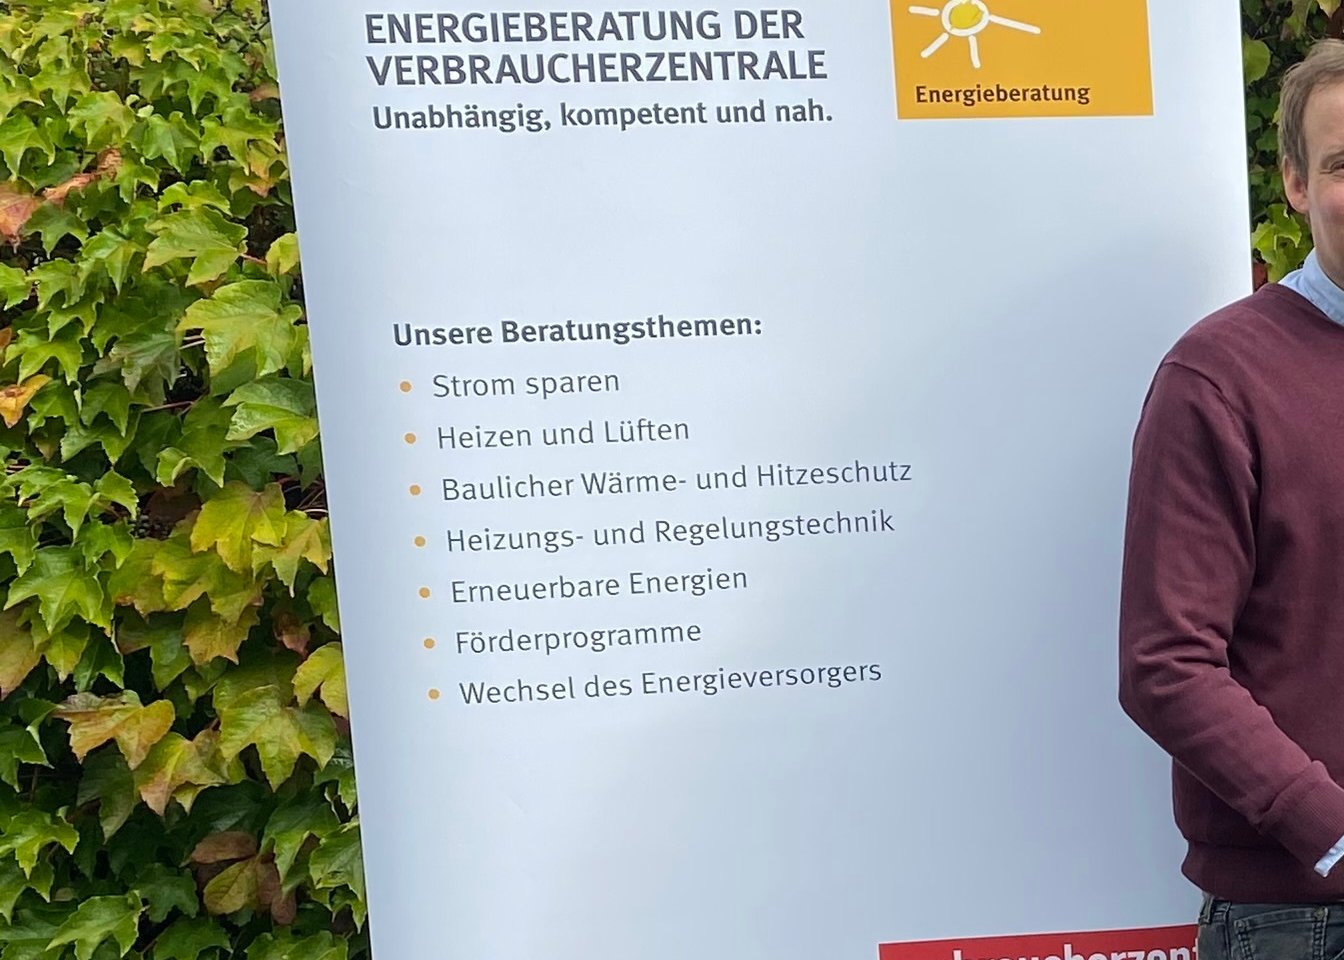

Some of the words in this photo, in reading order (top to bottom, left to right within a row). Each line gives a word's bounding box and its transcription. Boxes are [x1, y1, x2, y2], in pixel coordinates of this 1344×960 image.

[366, 11, 721, 43] ENERGIEBERATUNG
[735, 10, 804, 39] DER
[366, 50, 827, 85] VERBRAUCHERZENTRALE
[916, 84, 1090, 106] Energieberatung
[373, 103, 551, 132] Unabhängig,
[561, 103, 707, 131] kompetent
[717, 99, 765, 123] und
[776, 98, 832, 121] nah.
[394, 324, 492, 346] Unsere
[502, 315, 761, 344] Beratungsthemen:
[433, 375, 514, 397] Strom
[527, 375, 618, 399] sparen
[438, 426, 531, 449] Heizen
[543, 421, 593, 445] und
[605, 418, 688, 442] Lüften
[443, 474, 573, 500] Baulicher
[581, 472, 686, 494] Wärme-
[697, 465, 746, 489] und
[758, 460, 911, 486] Hitzeschutz
[448, 528, 583, 553] Heizungs-
[594, 521, 644, 545] und
[656, 509, 895, 545] Regelungstechnik
[452, 576, 619, 602] Erneuerbare
[630, 568, 746, 596] Energien
[457, 625, 700, 655] Förderprogramme
[459, 677, 574, 704] Wechsel
[585, 675, 632, 697] des
[643, 665, 881, 695] Energieversorgers
